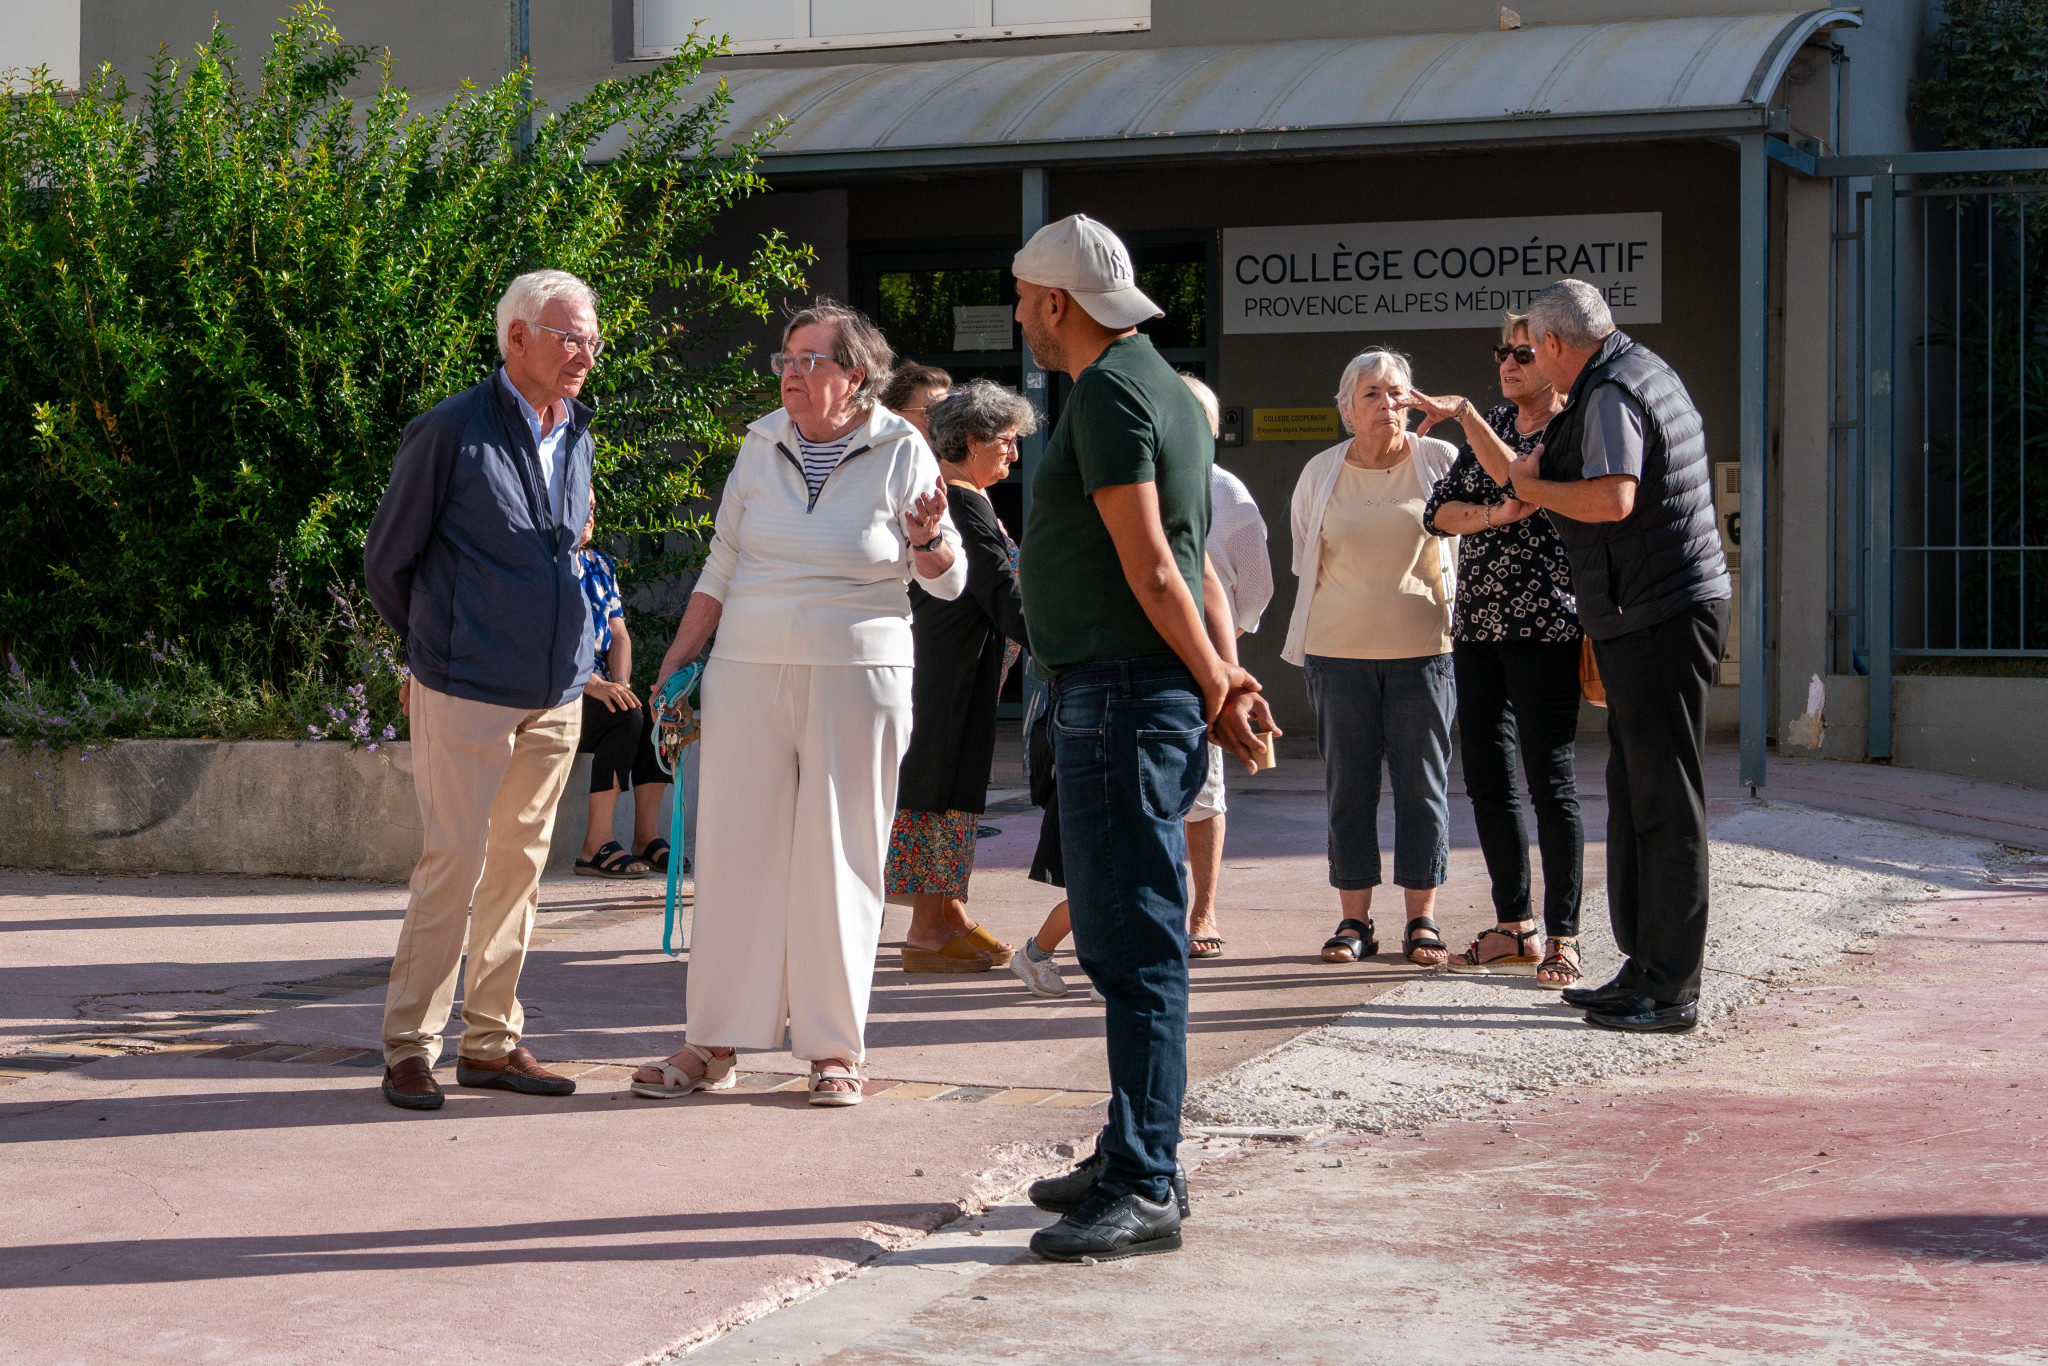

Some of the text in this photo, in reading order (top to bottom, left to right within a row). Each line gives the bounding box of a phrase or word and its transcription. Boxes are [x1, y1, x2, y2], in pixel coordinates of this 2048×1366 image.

[1235, 235, 1648, 285] COLLÈGE COOPÉRATIF
[1244, 282, 1638, 318] PROVENCE ALPES MÉDITEÉE
[1291, 414, 1327, 422] COOPERATIF
